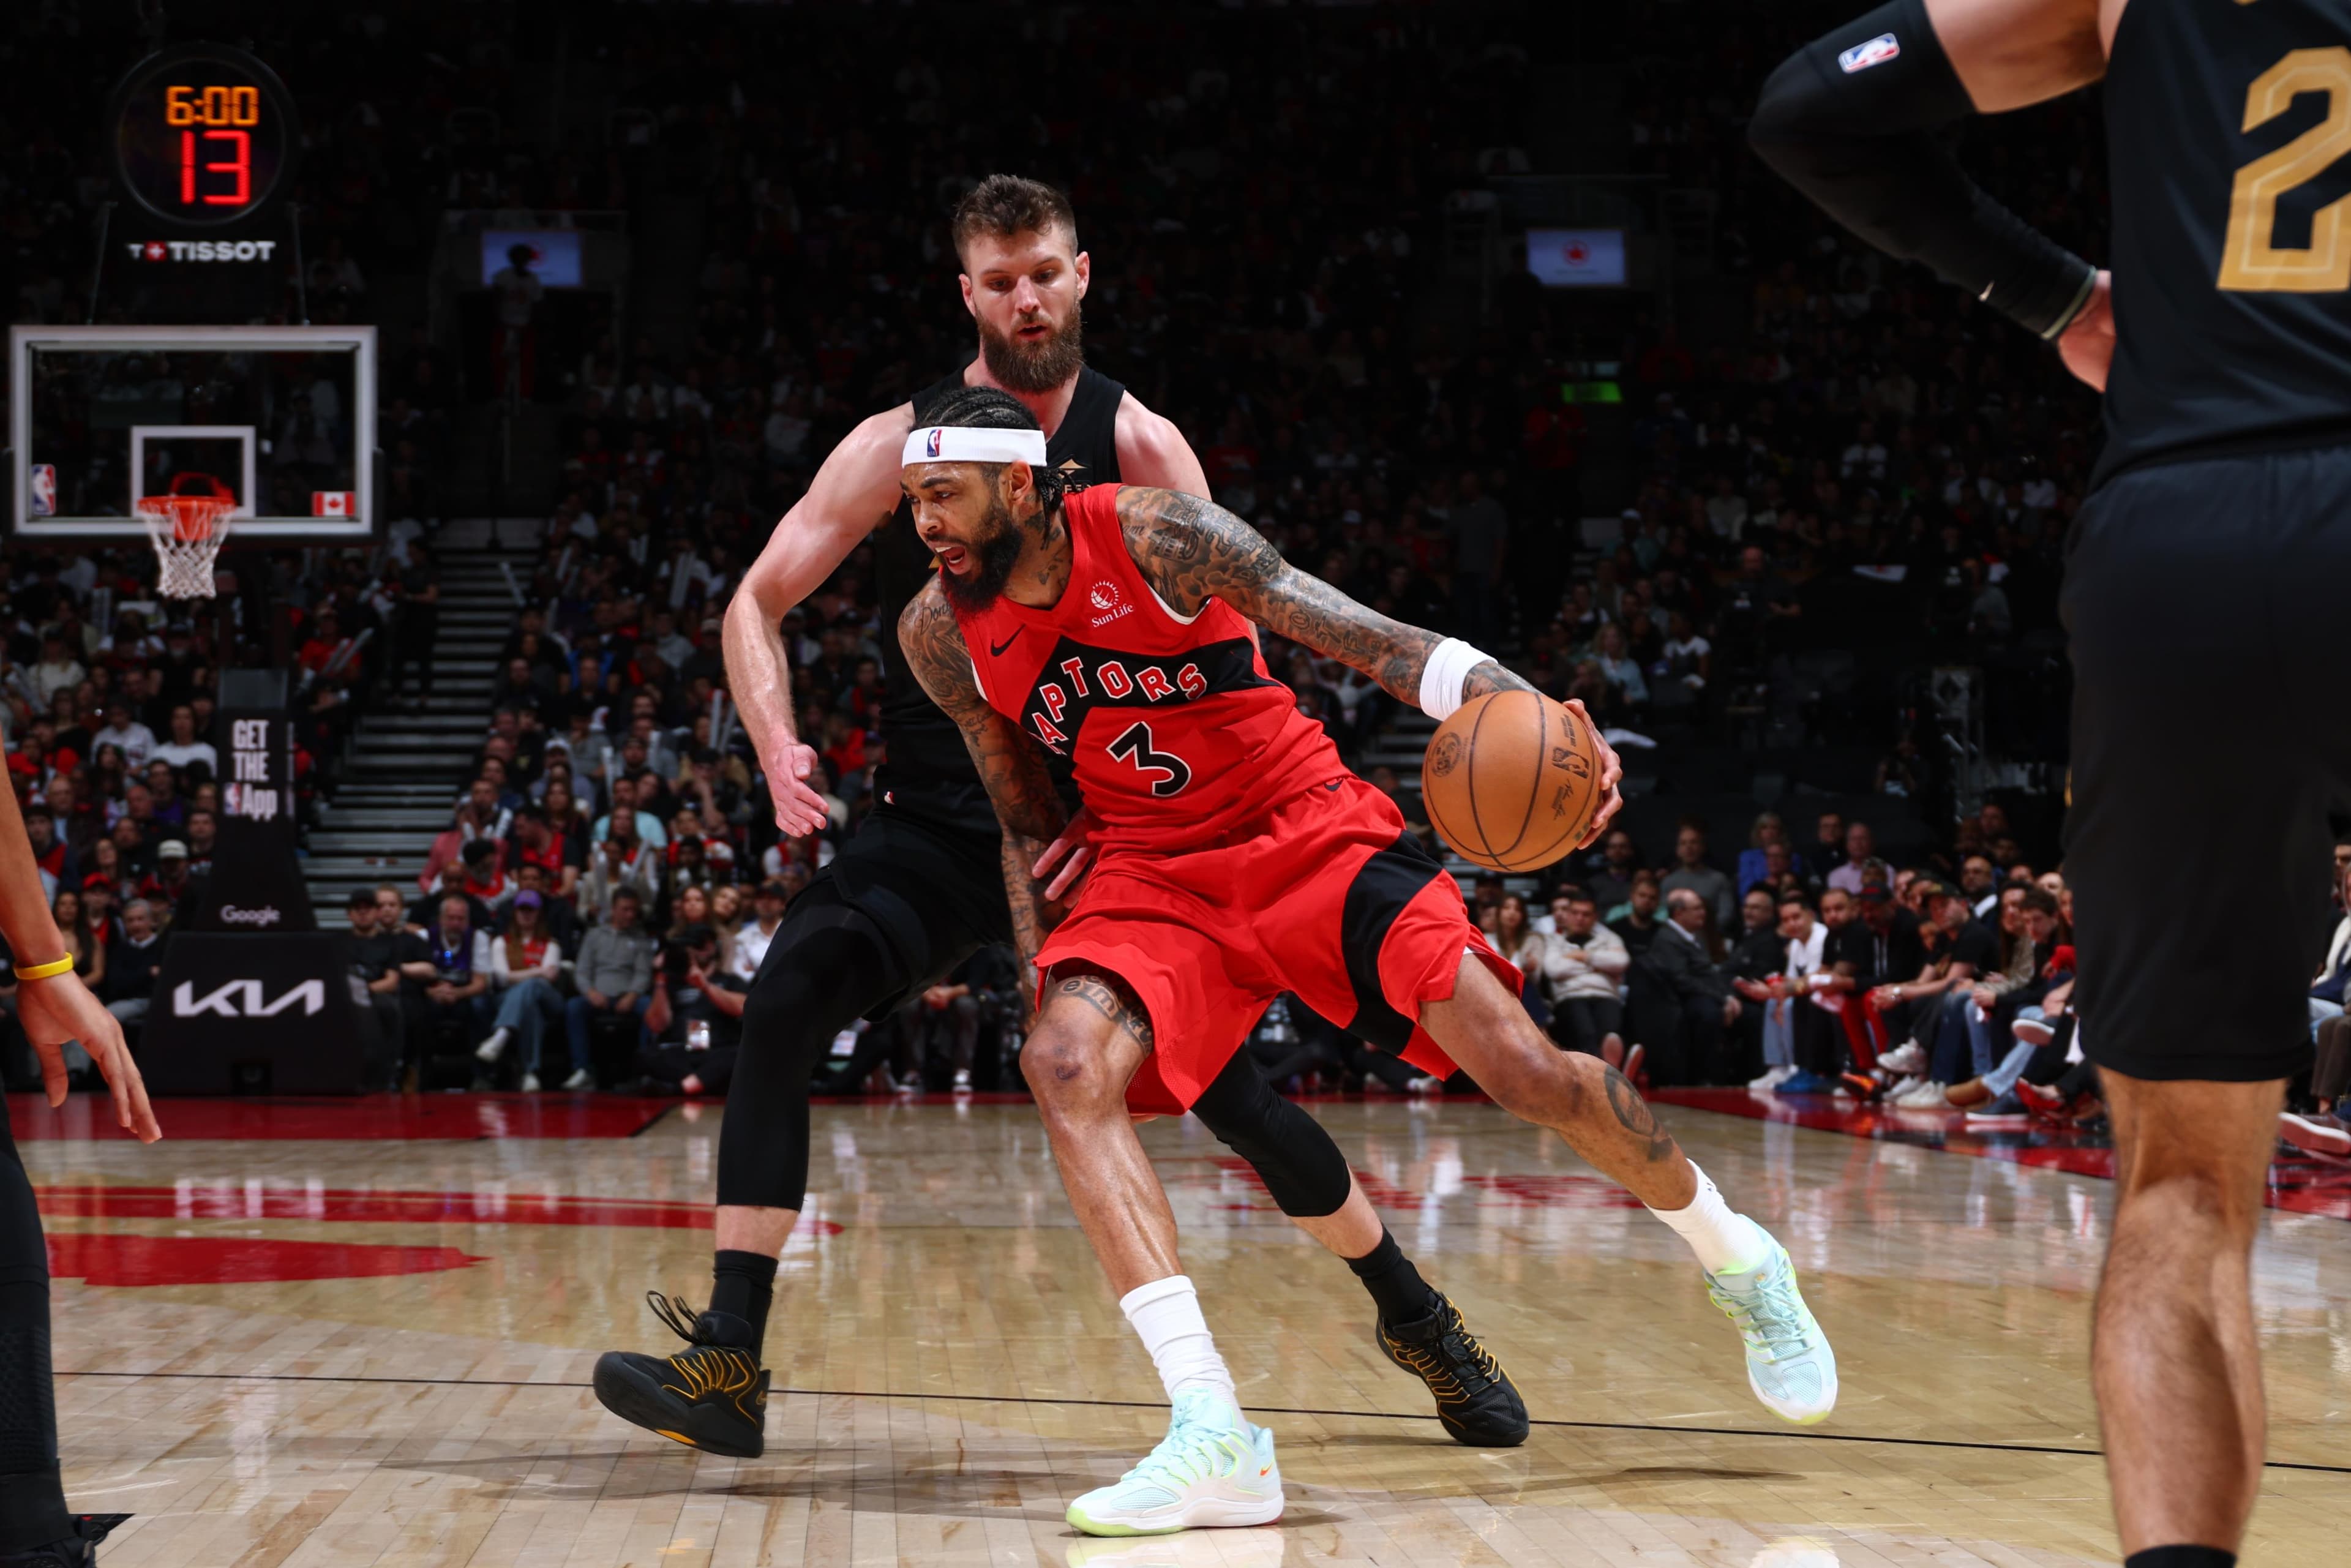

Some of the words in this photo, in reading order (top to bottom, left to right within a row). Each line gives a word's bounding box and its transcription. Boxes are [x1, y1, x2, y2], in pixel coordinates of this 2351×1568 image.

[167, 86, 260, 126] 6:00
[181, 130, 251, 204] 13
[168, 241, 276, 261] TISSOT
[1092, 613, 1114, 628] Sun
[1112, 603, 1134, 618] Life
[1029, 656, 1207, 756] APTORS
[233, 719, 269, 749] GET
[232, 751, 269, 782] THE
[1106, 721, 1191, 797] 3
[241, 782, 277, 822] App
[220, 904, 280, 927] Google
